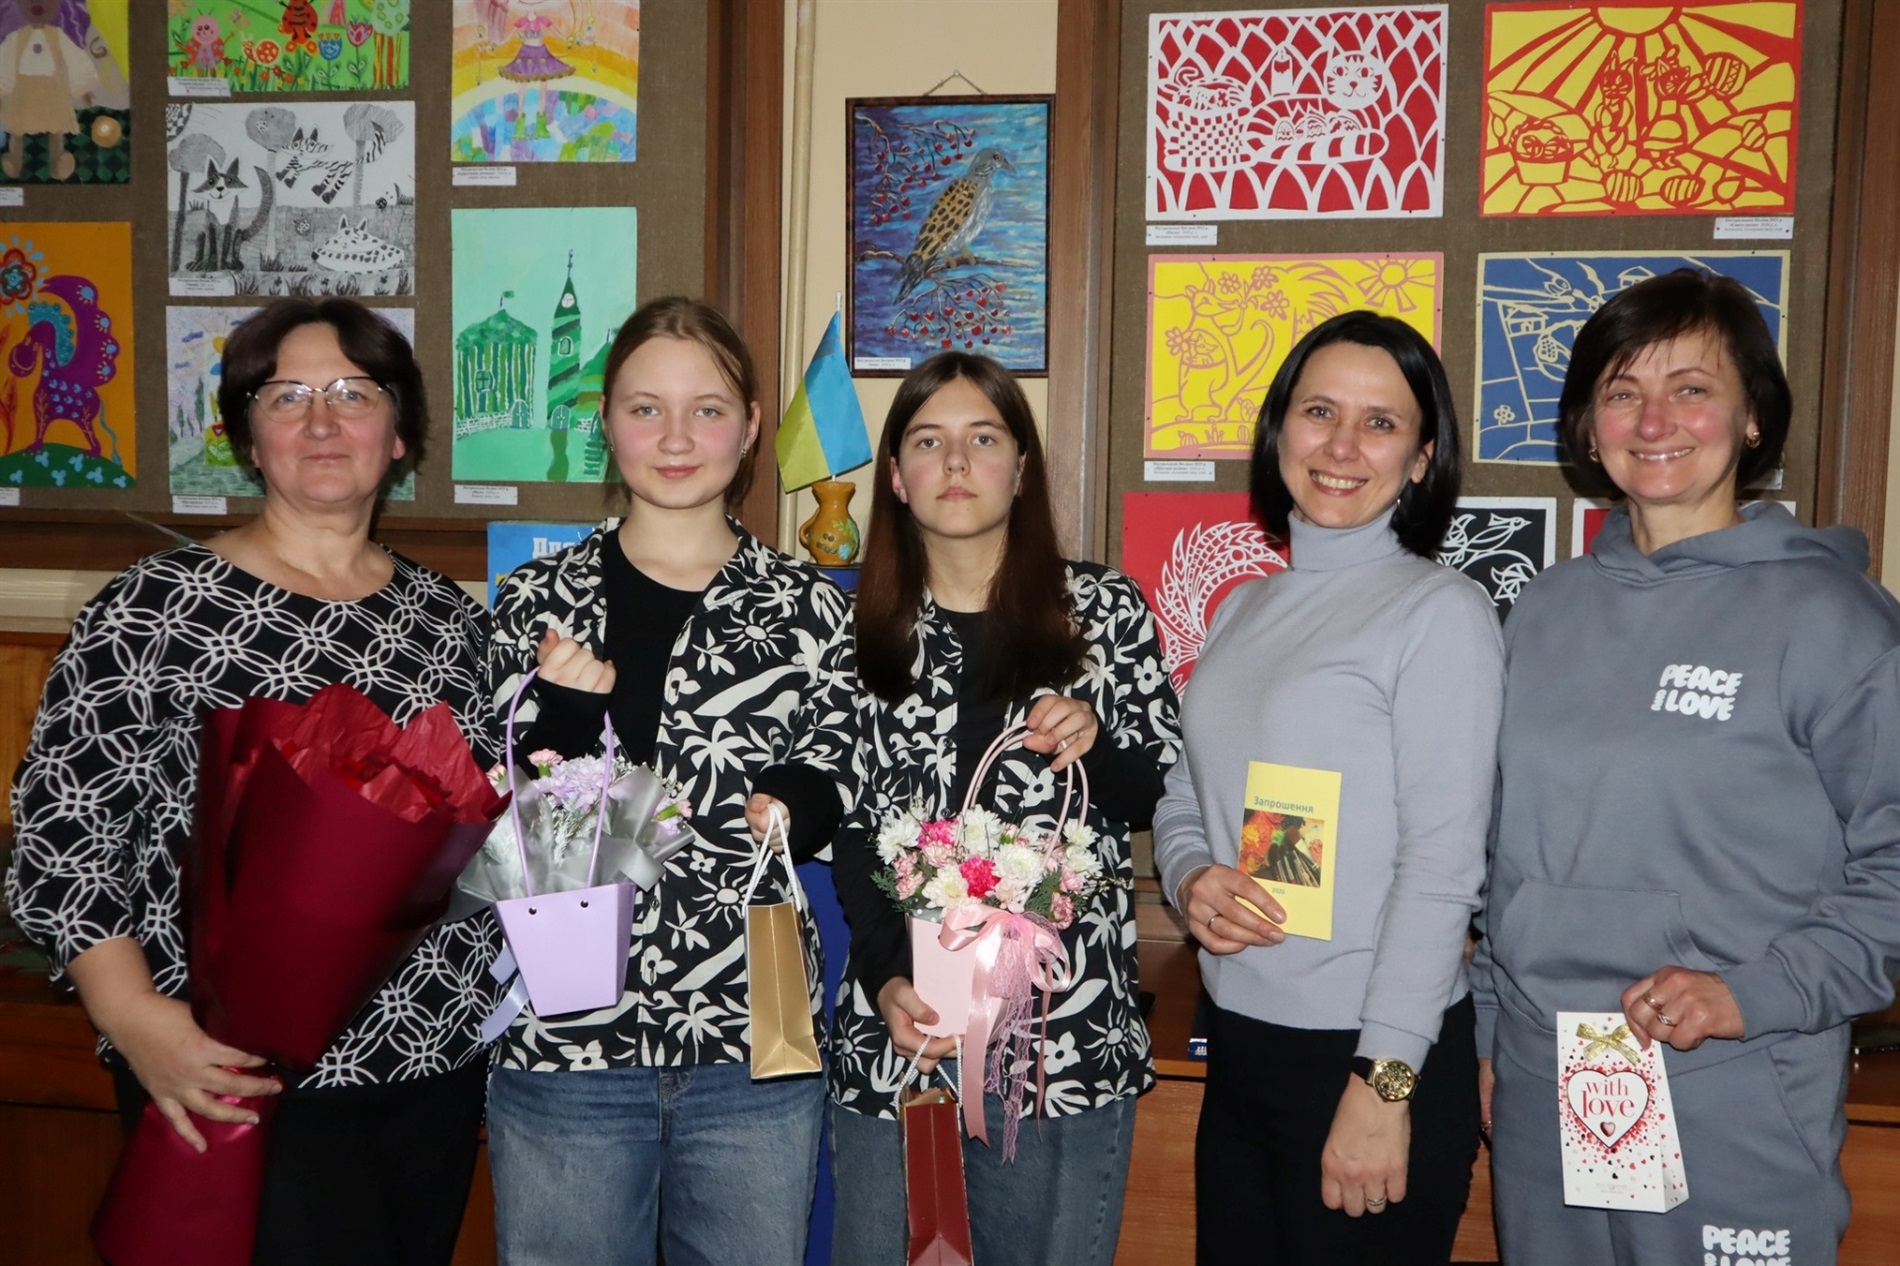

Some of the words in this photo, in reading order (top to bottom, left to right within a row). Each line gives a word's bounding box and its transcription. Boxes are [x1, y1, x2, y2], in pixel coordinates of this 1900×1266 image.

[1659, 664, 1743, 696] PEACE
[1665, 689, 1736, 721] LOVE
[1253, 796, 1314, 814] Запрошення
[1586, 1078, 1629, 1097] with
[1582, 1090, 1635, 1119] love
[1702, 1224, 1791, 1256] PEACE
